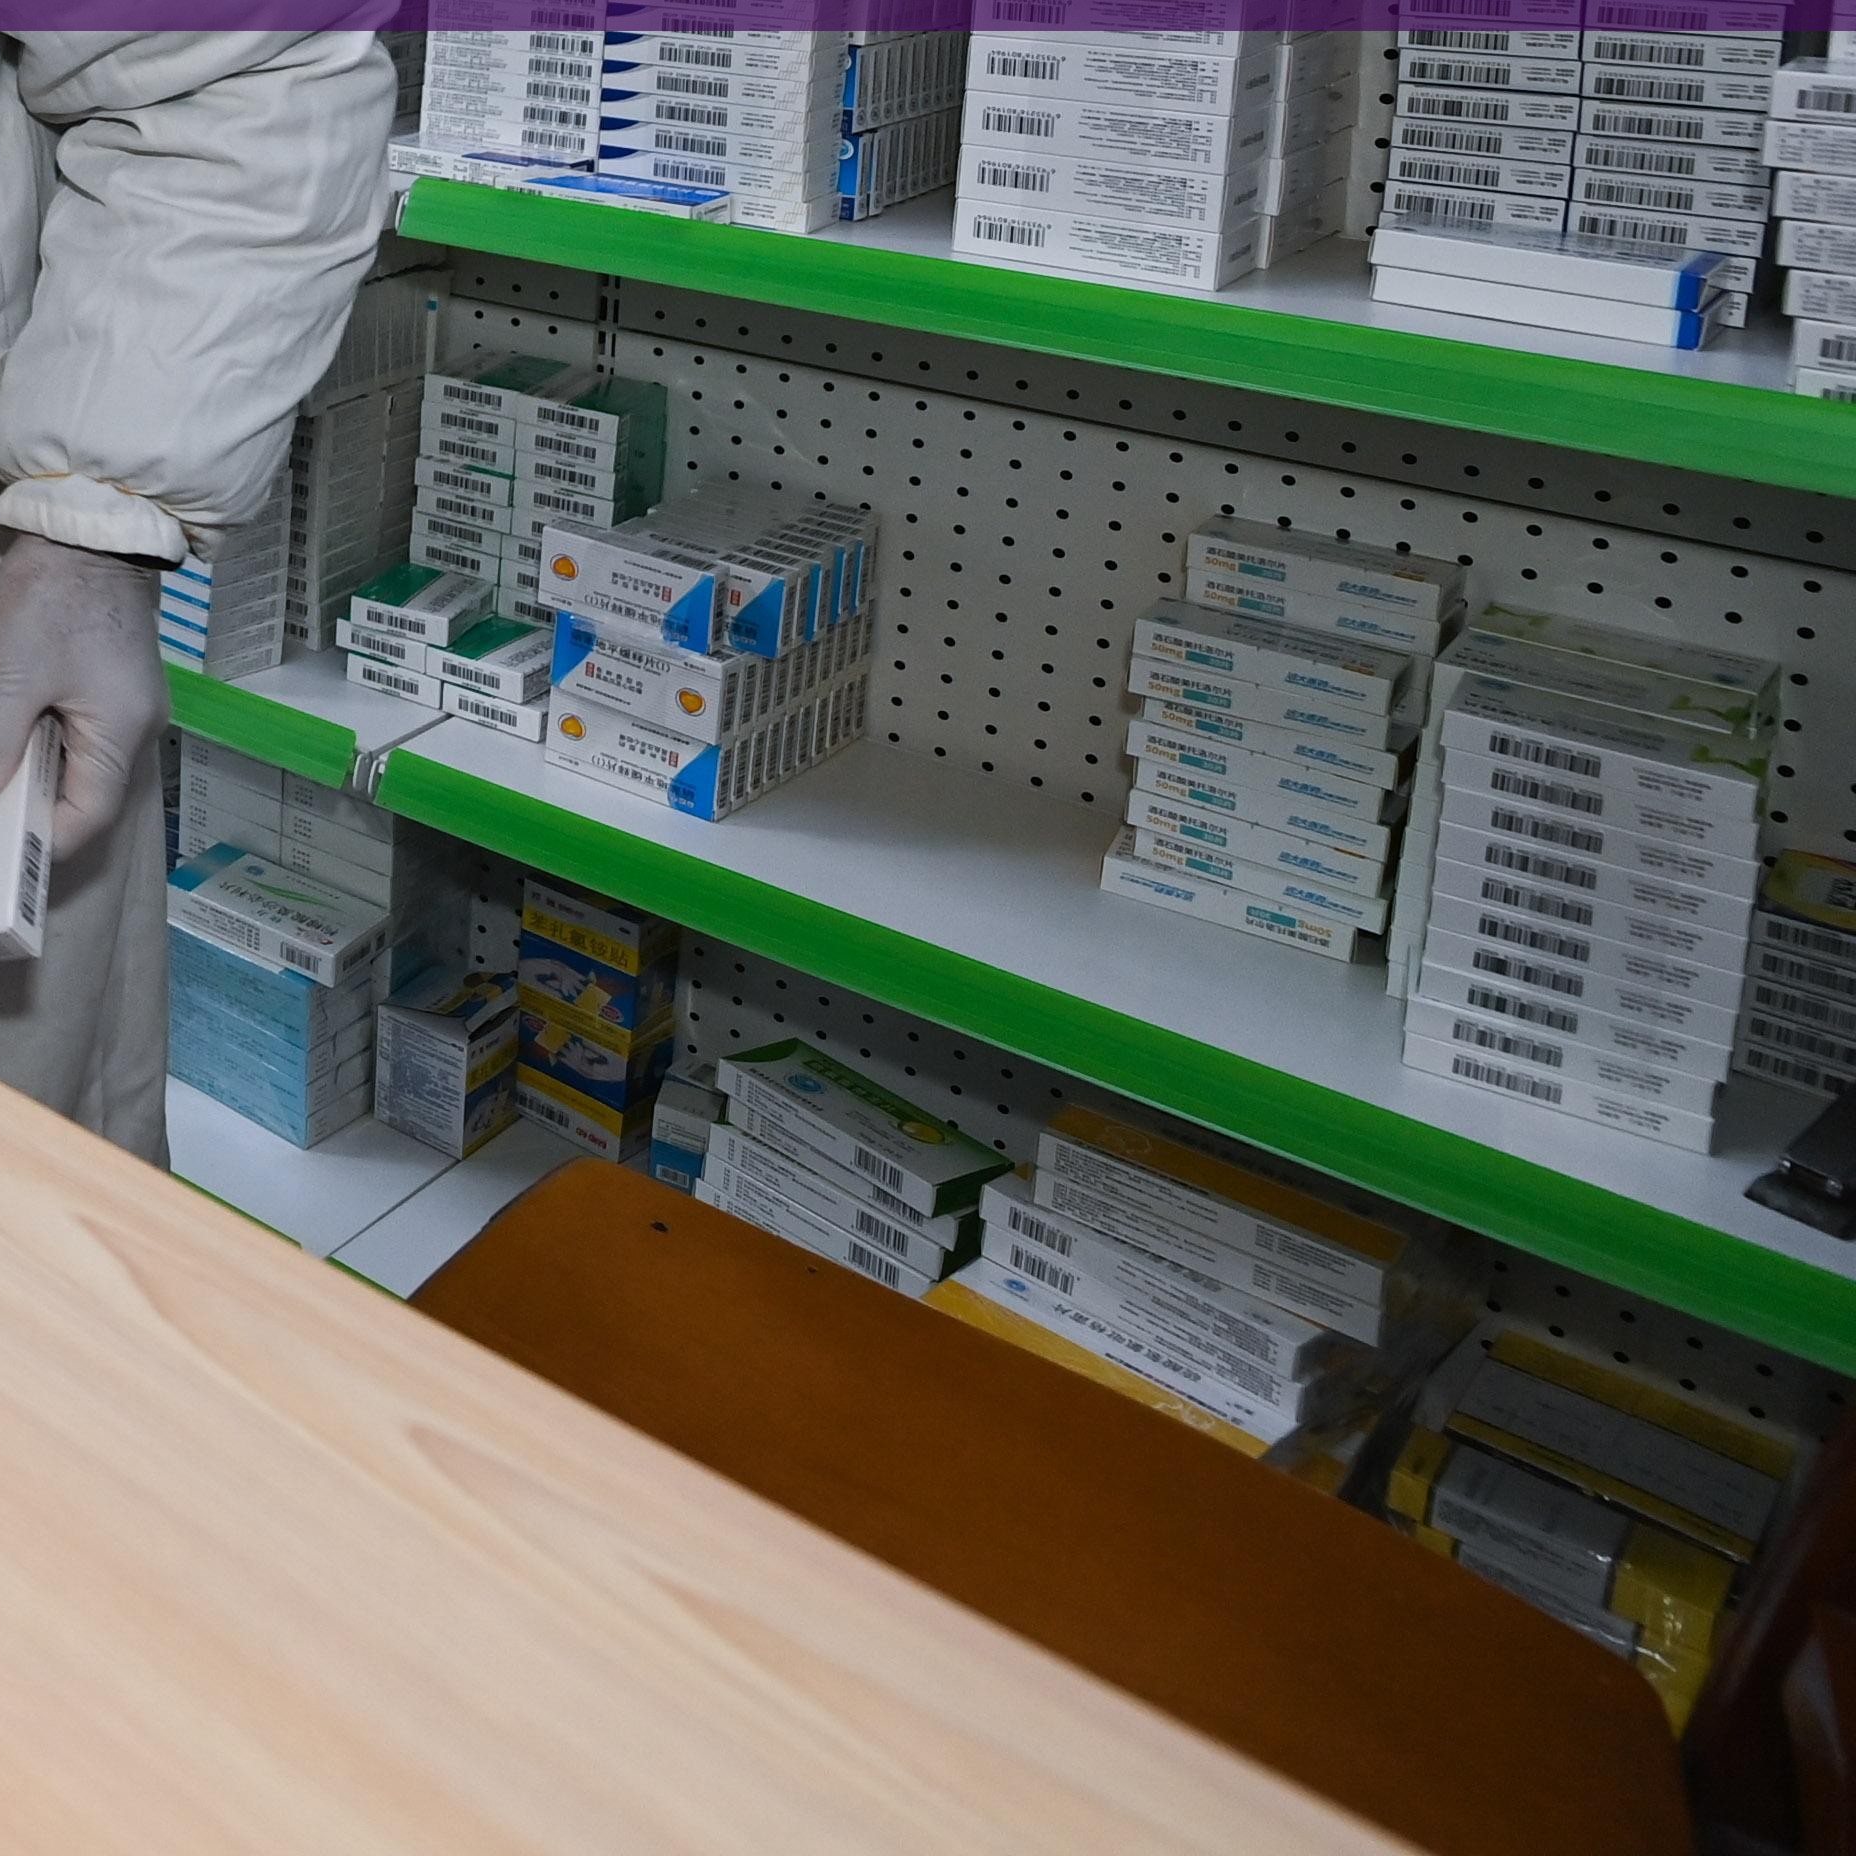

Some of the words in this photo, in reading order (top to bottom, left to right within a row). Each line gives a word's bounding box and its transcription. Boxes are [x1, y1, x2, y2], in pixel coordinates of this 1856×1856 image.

[1205, 556, 1236, 572] 50mg
[1206, 546, 1286, 570] 酒石酸美托洛尔片
[1205, 590, 1236, 606] 50mg
[1206, 580, 1286, 605] 酒石酸美托洛尔片
[1151, 642, 1184, 659] 50mg
[1153, 632, 1235, 660] 酒石酸美托洛尔片
[1147, 680, 1181, 697] 50mg
[1149, 670, 1232, 697] 酒石酸美托洛尔片
[1161, 710, 1193, 728] 50mg
[1164, 702, 1244, 730] 酒石酸美托洛尔片
[1145, 744, 1177, 762] 50mg
[1147, 734, 1227, 764] 酒石酸美托洛尔片
[1155, 779, 1186, 797] 50mg
[1156, 769, 1236, 801] 酒石酸美托洛尔片
[1145, 815, 1178, 833] 50mg
[1148, 805, 1227, 835] 酒石酸美托洛尔片
[1152, 847, 1184, 865] 50mg
[1155, 838, 1234, 869] 酒石酸美托洛尔片
[1245, 917, 1330, 948] 酒石酸美托洛尔片
[1298, 919, 1332, 939] 50mg
[1052, 1302, 1203, 1383] 硫酸氢氯吡格雷片
